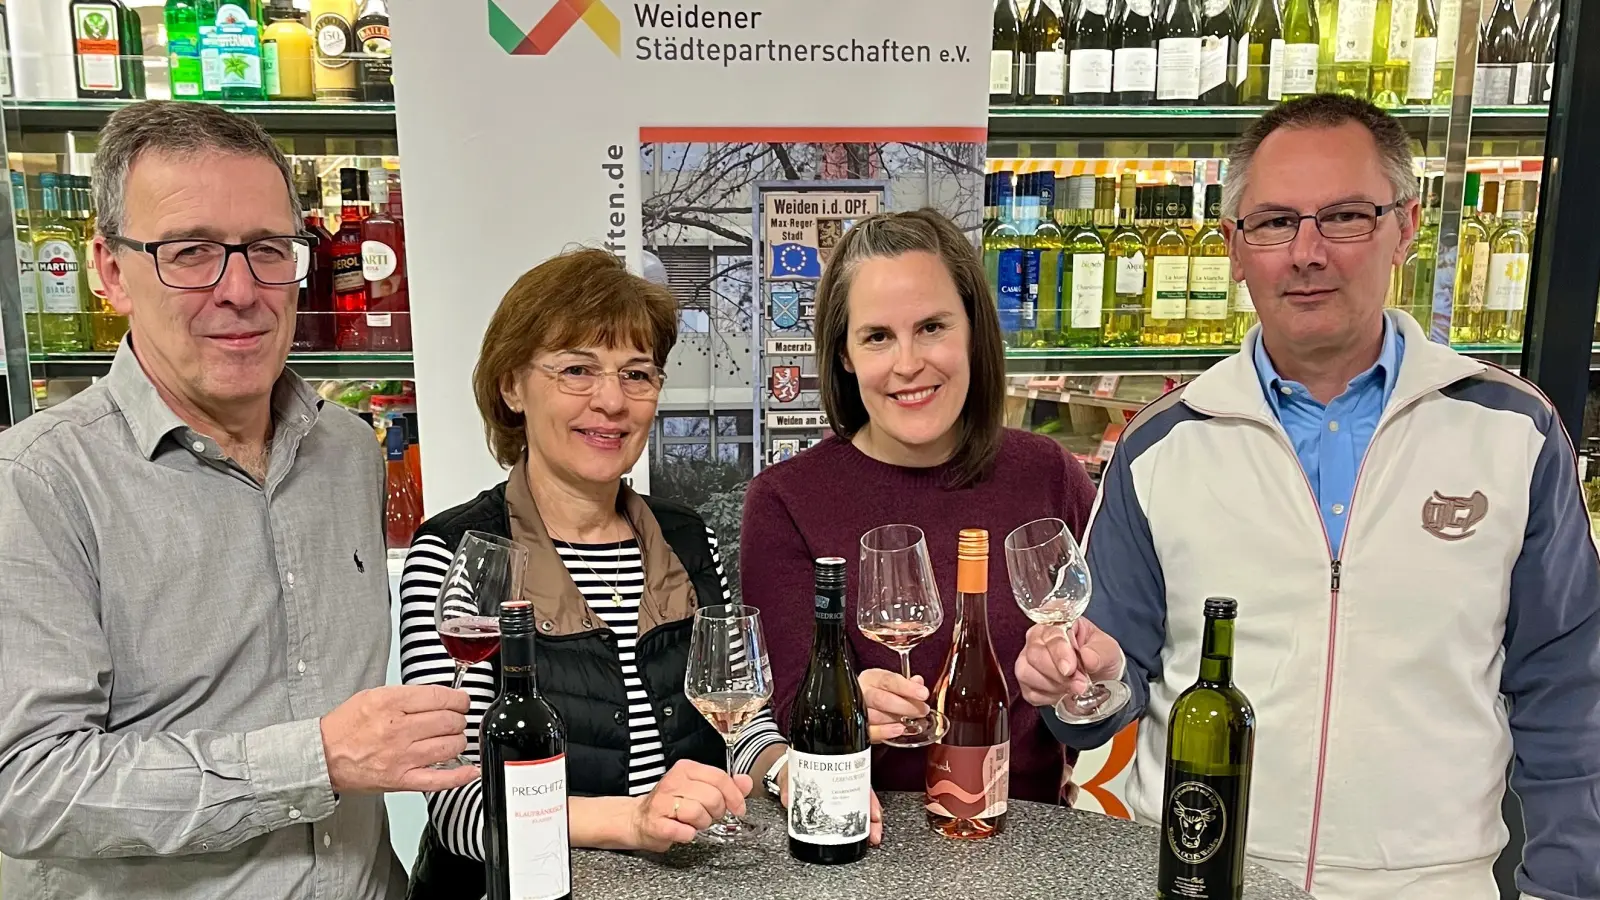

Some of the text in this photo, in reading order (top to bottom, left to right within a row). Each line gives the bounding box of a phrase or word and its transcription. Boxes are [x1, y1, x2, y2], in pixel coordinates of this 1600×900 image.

[635, 4, 763, 29] Weidener
[635, 36, 971, 67] Städtepartnerschaften e.V.
[774, 199, 871, 215] Weiden i.d. OPf.
[782, 231, 803, 241] Stadt
[39, 262, 77, 272] MARTINI
[46, 286, 76, 294] BIANCO
[775, 342, 812, 352] Macerata
[776, 415, 829, 426] Weiden am Se
[798, 758, 852, 772] FRIEDRICH
[511, 778, 564, 797] PRESCHITZ
